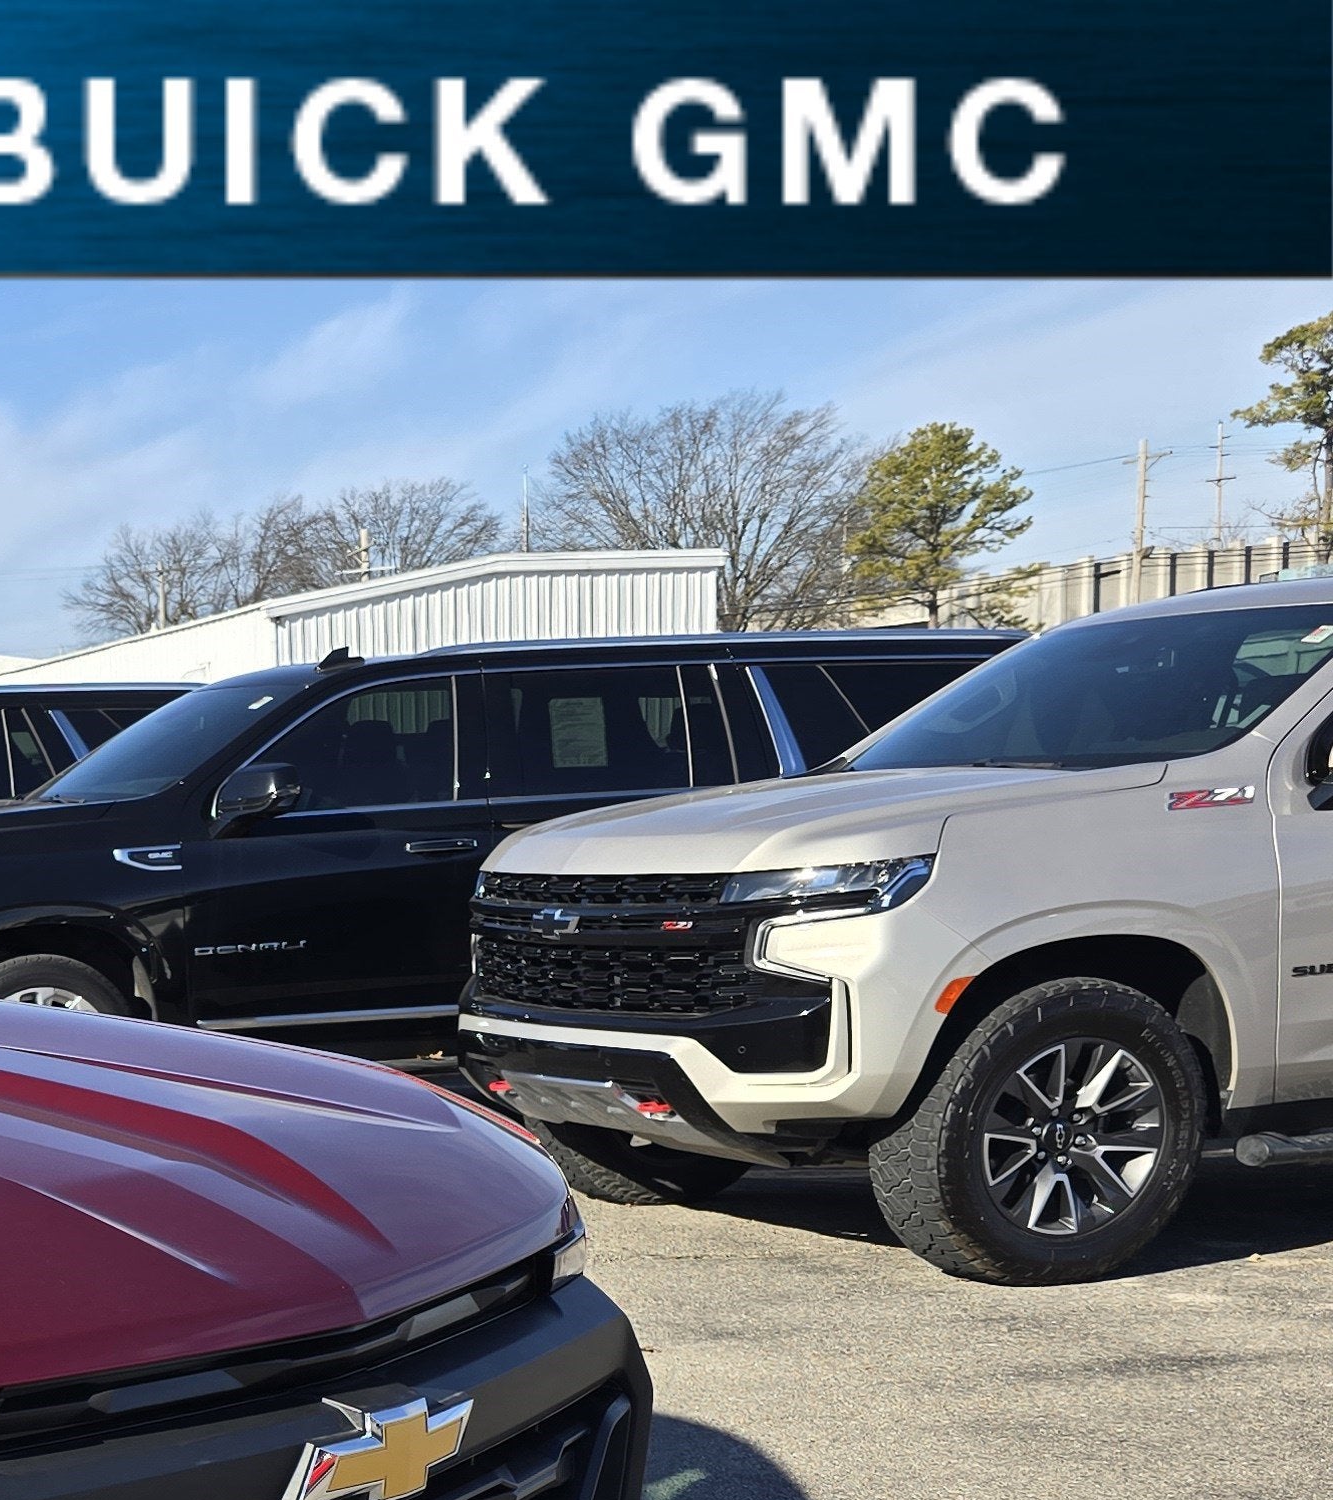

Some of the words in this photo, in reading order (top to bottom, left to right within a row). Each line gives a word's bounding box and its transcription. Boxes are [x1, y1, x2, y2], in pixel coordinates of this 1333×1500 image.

[1167, 785, 1255, 810] Z71
[660, 920, 694, 932] Z71
[194, 940, 307, 956] DENALI
